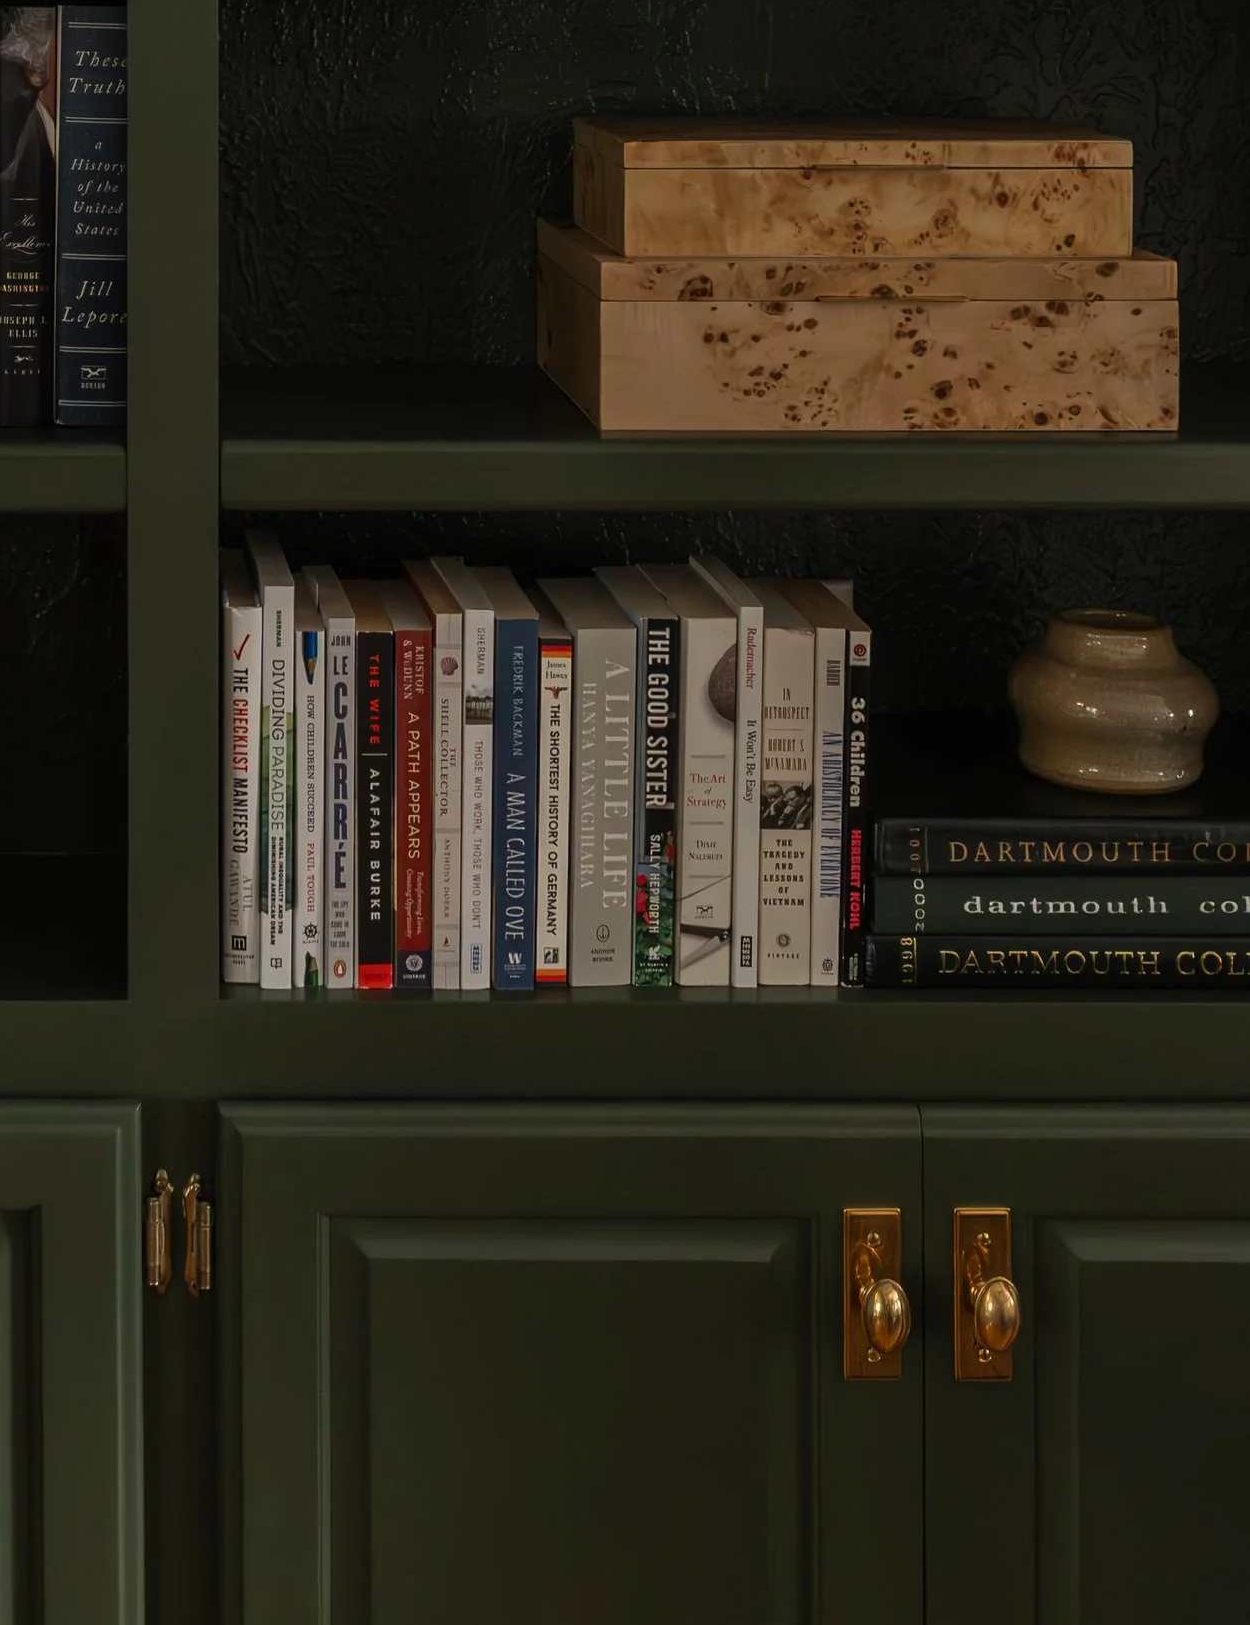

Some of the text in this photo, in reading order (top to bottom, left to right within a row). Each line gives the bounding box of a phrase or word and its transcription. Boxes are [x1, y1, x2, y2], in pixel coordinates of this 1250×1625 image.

[62, 307, 127, 324] Lepore
[75, 280, 112, 300] Jill
[369, 654, 379, 744] THE WIFE
[745, 628, 757, 689] Rademacher
[232, 668, 249, 853] THE CHECKLIST MANIFESTO
[271, 660, 285, 830] DIVIDING PARADISE
[646, 627, 669, 807] THE GOOD SISTER
[849, 697, 865, 807] 36 Children
[408, 712, 419, 859] A PATH APPEARS
[603, 659, 629, 908] A LITTLE LIFE
[369, 769, 381, 921] ALAFAIR BURKE
[505, 772, 525, 940] A MAN CALLED OVE
[950, 841, 1171, 864] DARTMOUTH
[964, 896, 1168, 915] dartmouth
[939, 949, 1160, 976] DARTMOUTH
